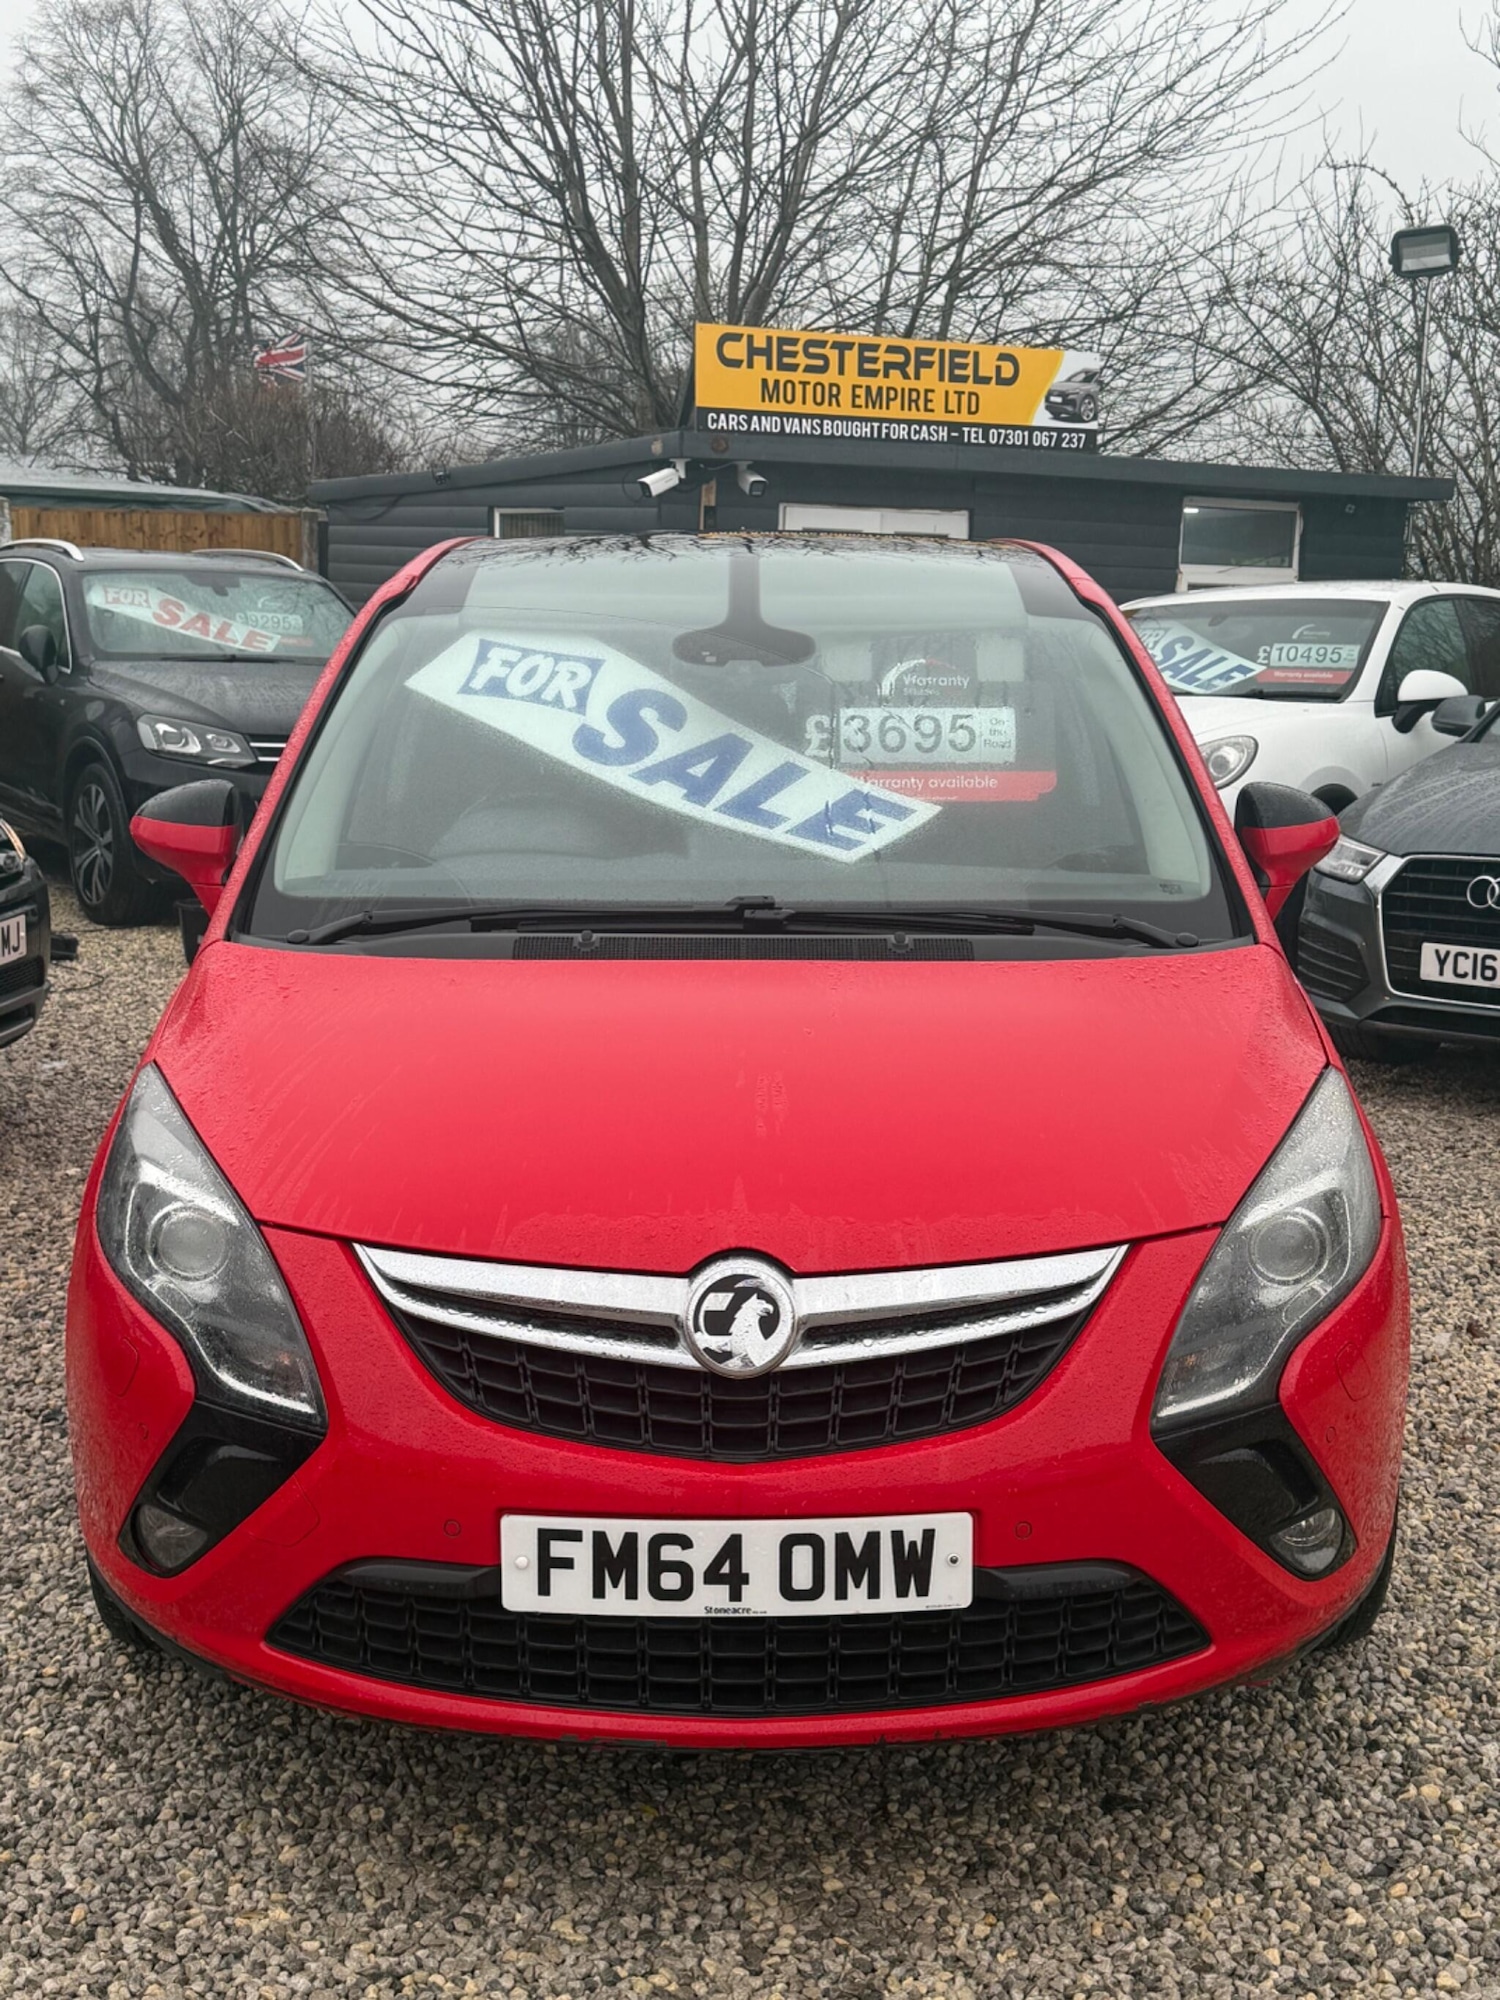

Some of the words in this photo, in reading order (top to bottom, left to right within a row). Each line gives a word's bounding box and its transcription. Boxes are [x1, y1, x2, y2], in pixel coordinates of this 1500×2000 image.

[716, 331, 1020, 386] CHESTERFIELD
[760, 378, 841, 408] MOTOR
[851, 384, 935, 414] EMPIRE
[944, 390, 980, 415] LTD
[707, 413, 748, 431] CARS
[751, 415, 781, 433] AND
[783, 417, 821, 435] VANS
[823, 420, 880, 438] BOUGHT
[882, 423, 908, 440] FOR
[911, 424, 948, 442] CASH
[962, 427, 985, 443] TEL
[989, 429, 1028, 446] 07301
[1033, 430, 1057, 447] 067
[1062, 432, 1086, 449] 237
[107, 589, 148, 607] FOR
[152, 598, 273, 651] SALE
[1157, 636, 1256, 691] SALE
[1257, 646, 1343, 664] £10495
[902, 674, 970, 689] Warranty
[472, 644, 593, 709] FOR
[572, 689, 918, 851] SALE
[928, 775, 998, 789] available
[1434, 948, 1498, 982] YC16
[537, 1528, 749, 1602] FM64
[779, 1528, 935, 1601] OMW
